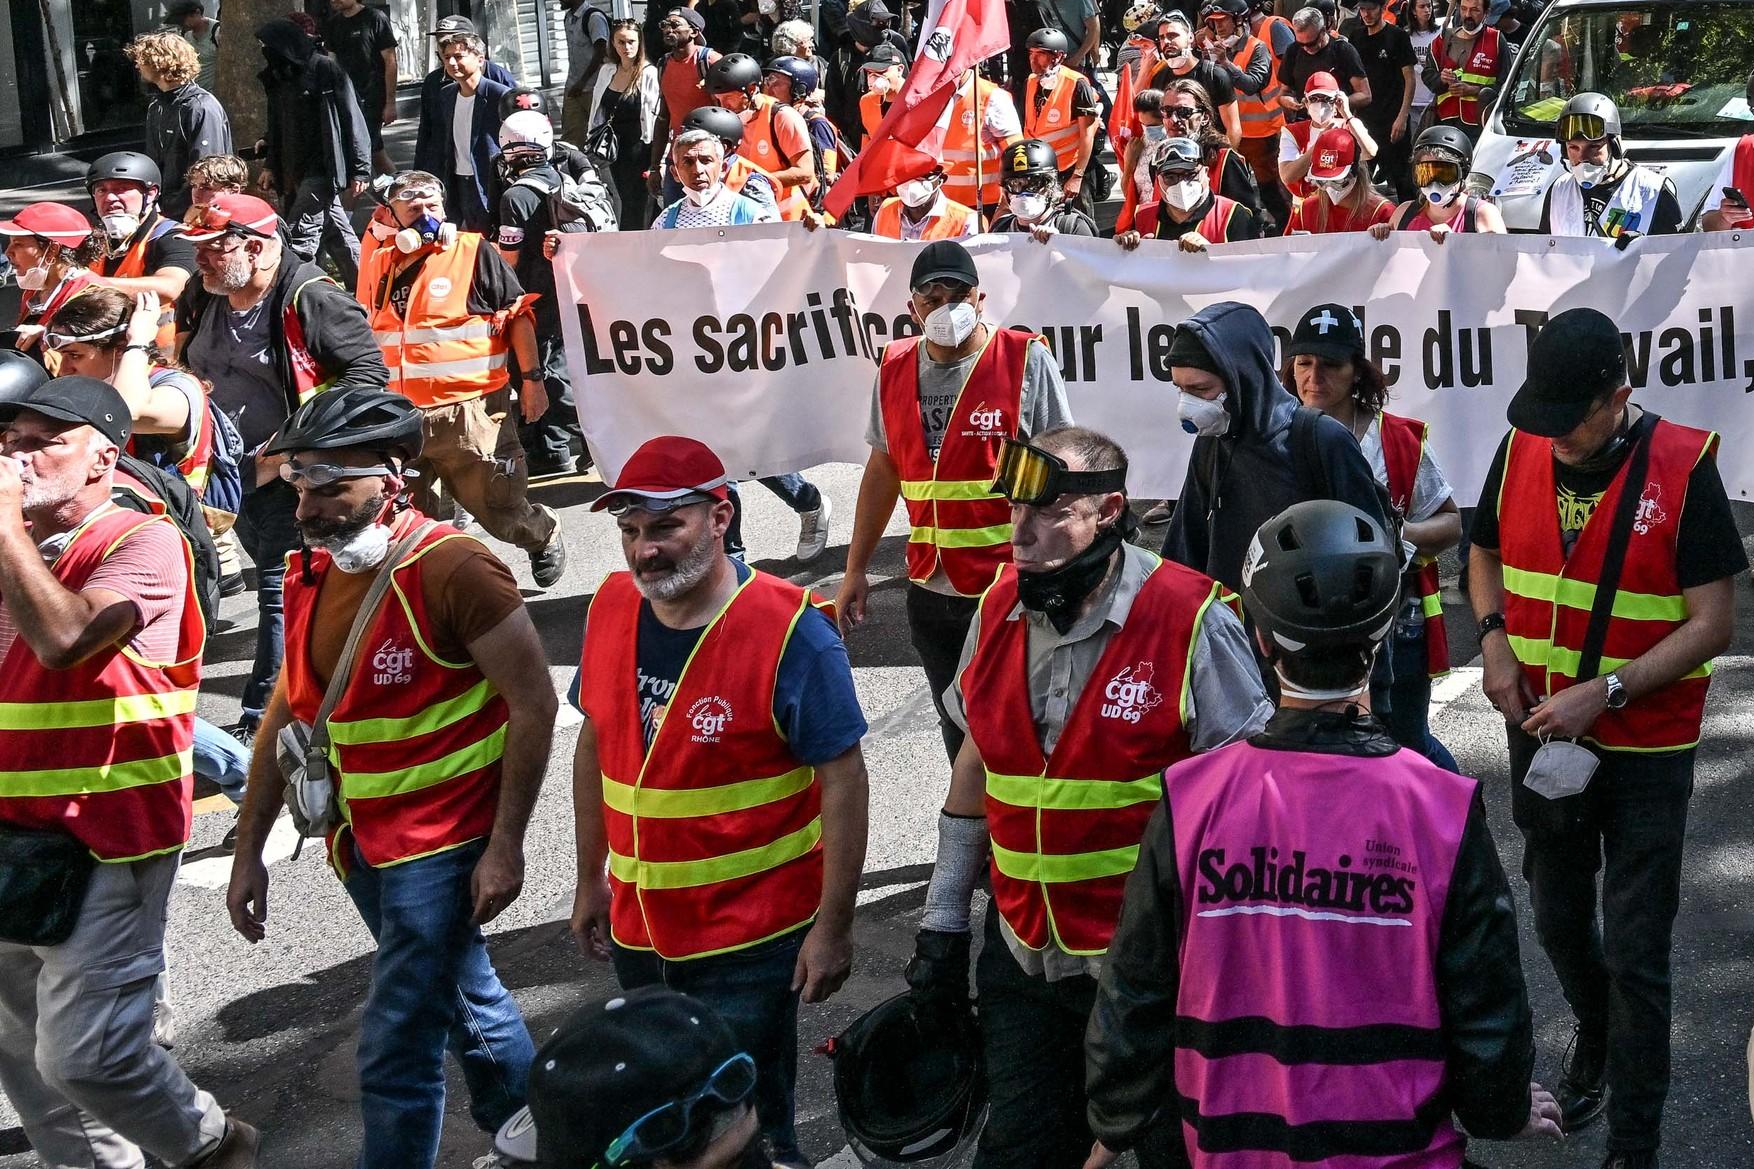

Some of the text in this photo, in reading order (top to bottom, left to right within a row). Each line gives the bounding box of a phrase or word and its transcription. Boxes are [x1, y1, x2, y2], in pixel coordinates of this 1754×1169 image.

[581, 304, 666, 376] Les
[692, 292, 923, 375] sacrifice
[1424, 308, 1494, 391] du
[969, 408, 1003, 431] cgt
[1635, 498, 1654, 522] gt
[373, 648, 414, 674] cgt
[373, 672, 412, 686] UD 69
[1105, 680, 1149, 708] cgt
[686, 695, 734, 722] Fonction Publique
[1101, 704, 1141, 724] UD 69
[692, 712, 726, 736] cgt
[691, 734, 721, 743] RHÔNE
[1365, 839, 1400, 856] Union
[1363, 855, 1418, 875] syndicale
[1197, 846, 1416, 915] Solidaires
